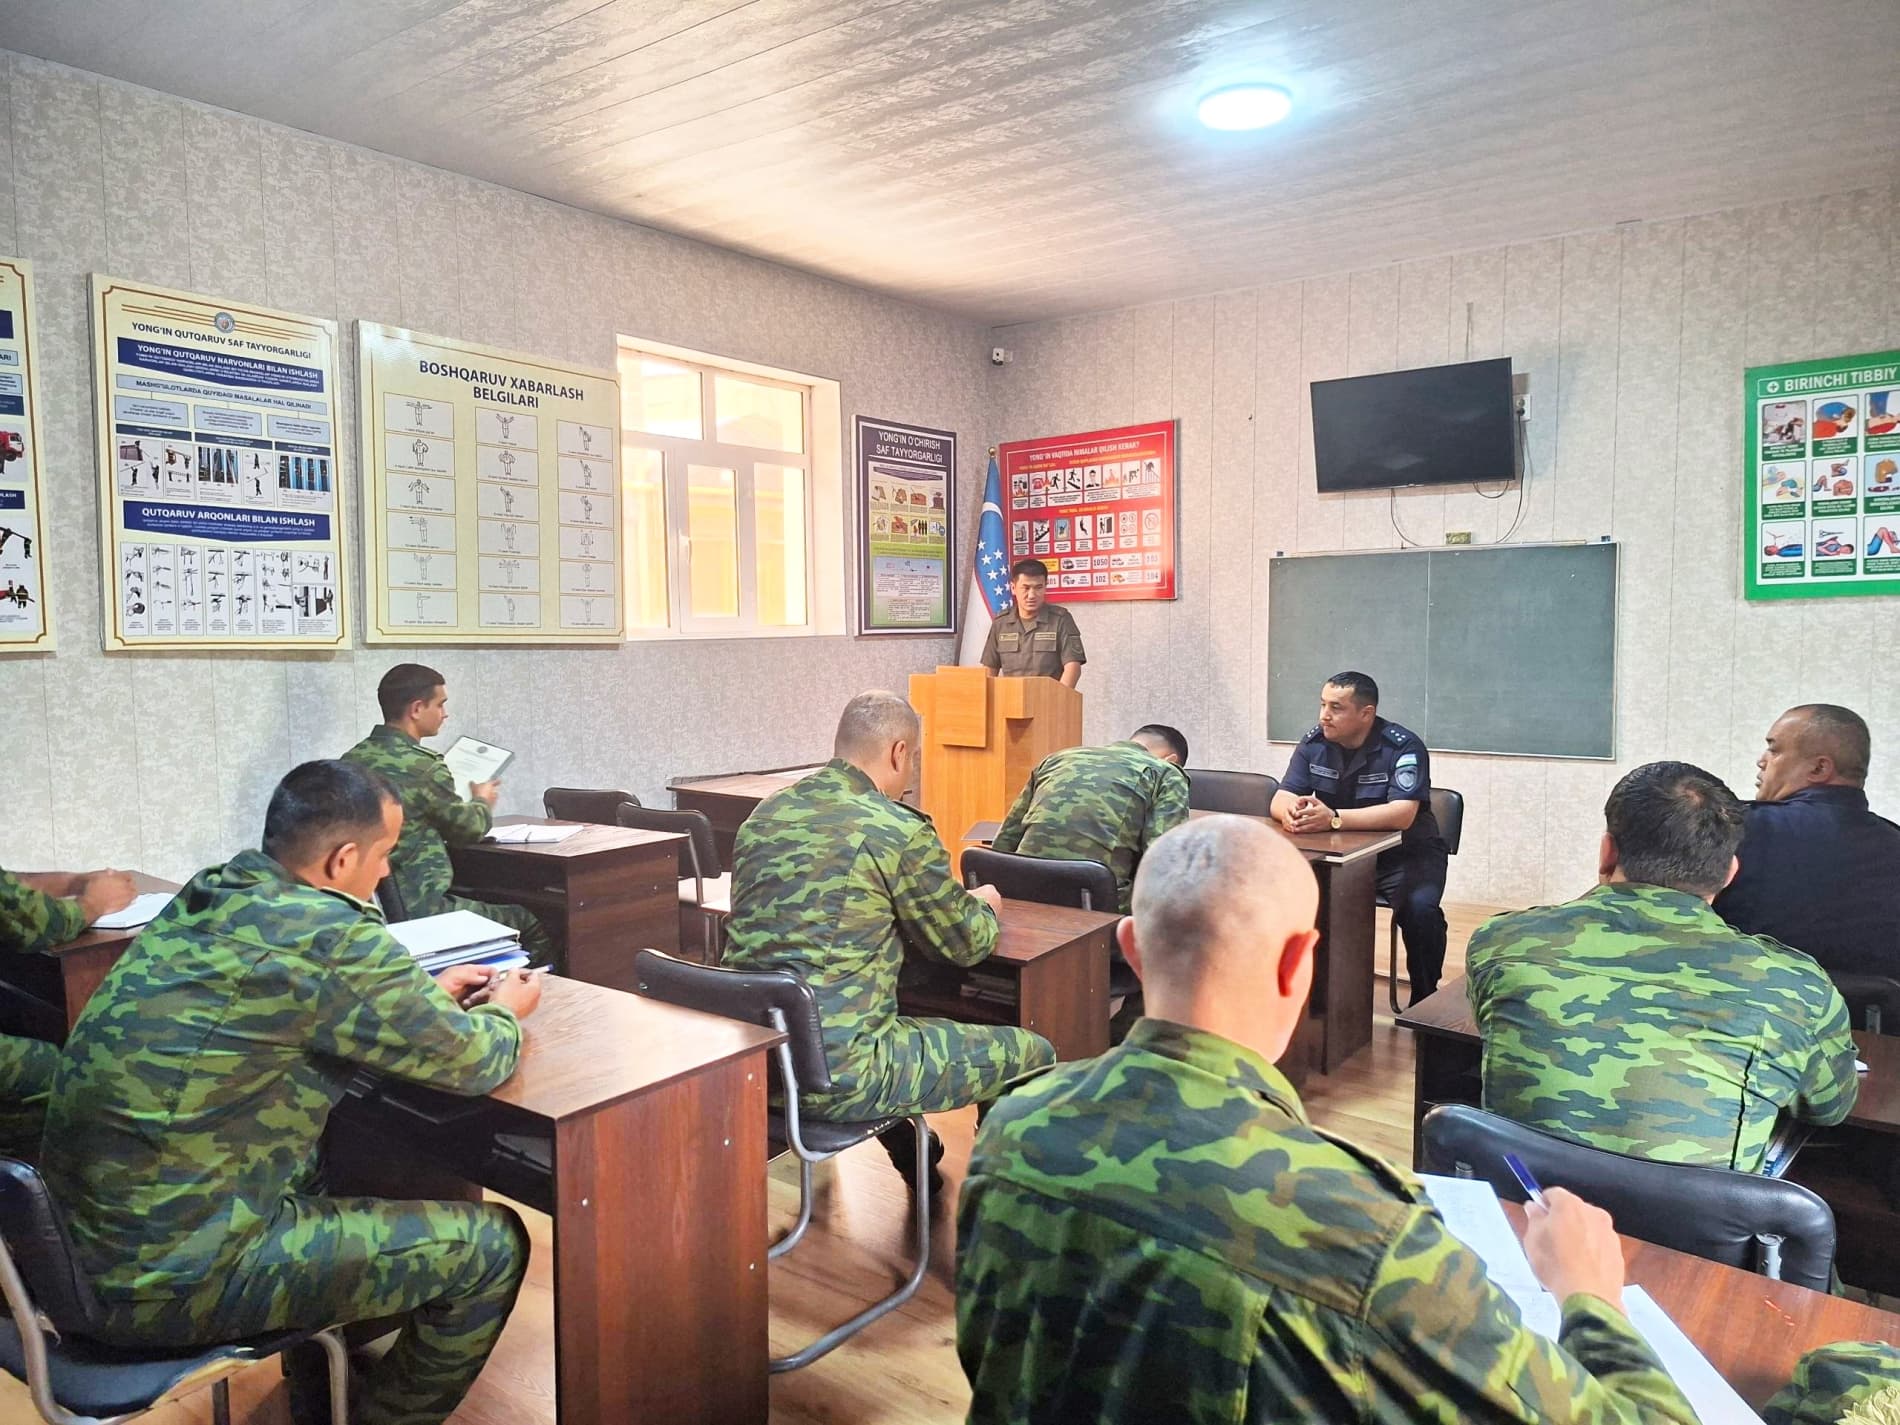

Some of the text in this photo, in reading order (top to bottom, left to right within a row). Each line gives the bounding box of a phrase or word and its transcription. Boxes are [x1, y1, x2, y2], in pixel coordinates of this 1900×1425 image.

[174, 329, 226, 345] QUTQARUV
[228, 338, 244, 348] SAF
[246, 341, 311, 359] TAYYORGARLIGI
[173, 350, 216, 363] QUTQARUV
[217, 356, 265, 371] NARVONLARI
[266, 364, 288, 375] BILAN
[288, 367, 318, 379] ISHLASH
[419, 360, 584, 401] BOSHQARUV XABARLASH
[1785, 366, 1898, 391] BIRINCHI TIBBIY
[473, 386, 539, 409] BELGILARI
[876, 444, 943, 464] SAF TAYYORGARLIGI
[142, 507, 195, 520] QUTQARUV
[197, 510, 251, 523] ARQONLARI
[252, 513, 279, 525] BILAN
[279, 516, 315, 528] ISHLASH
